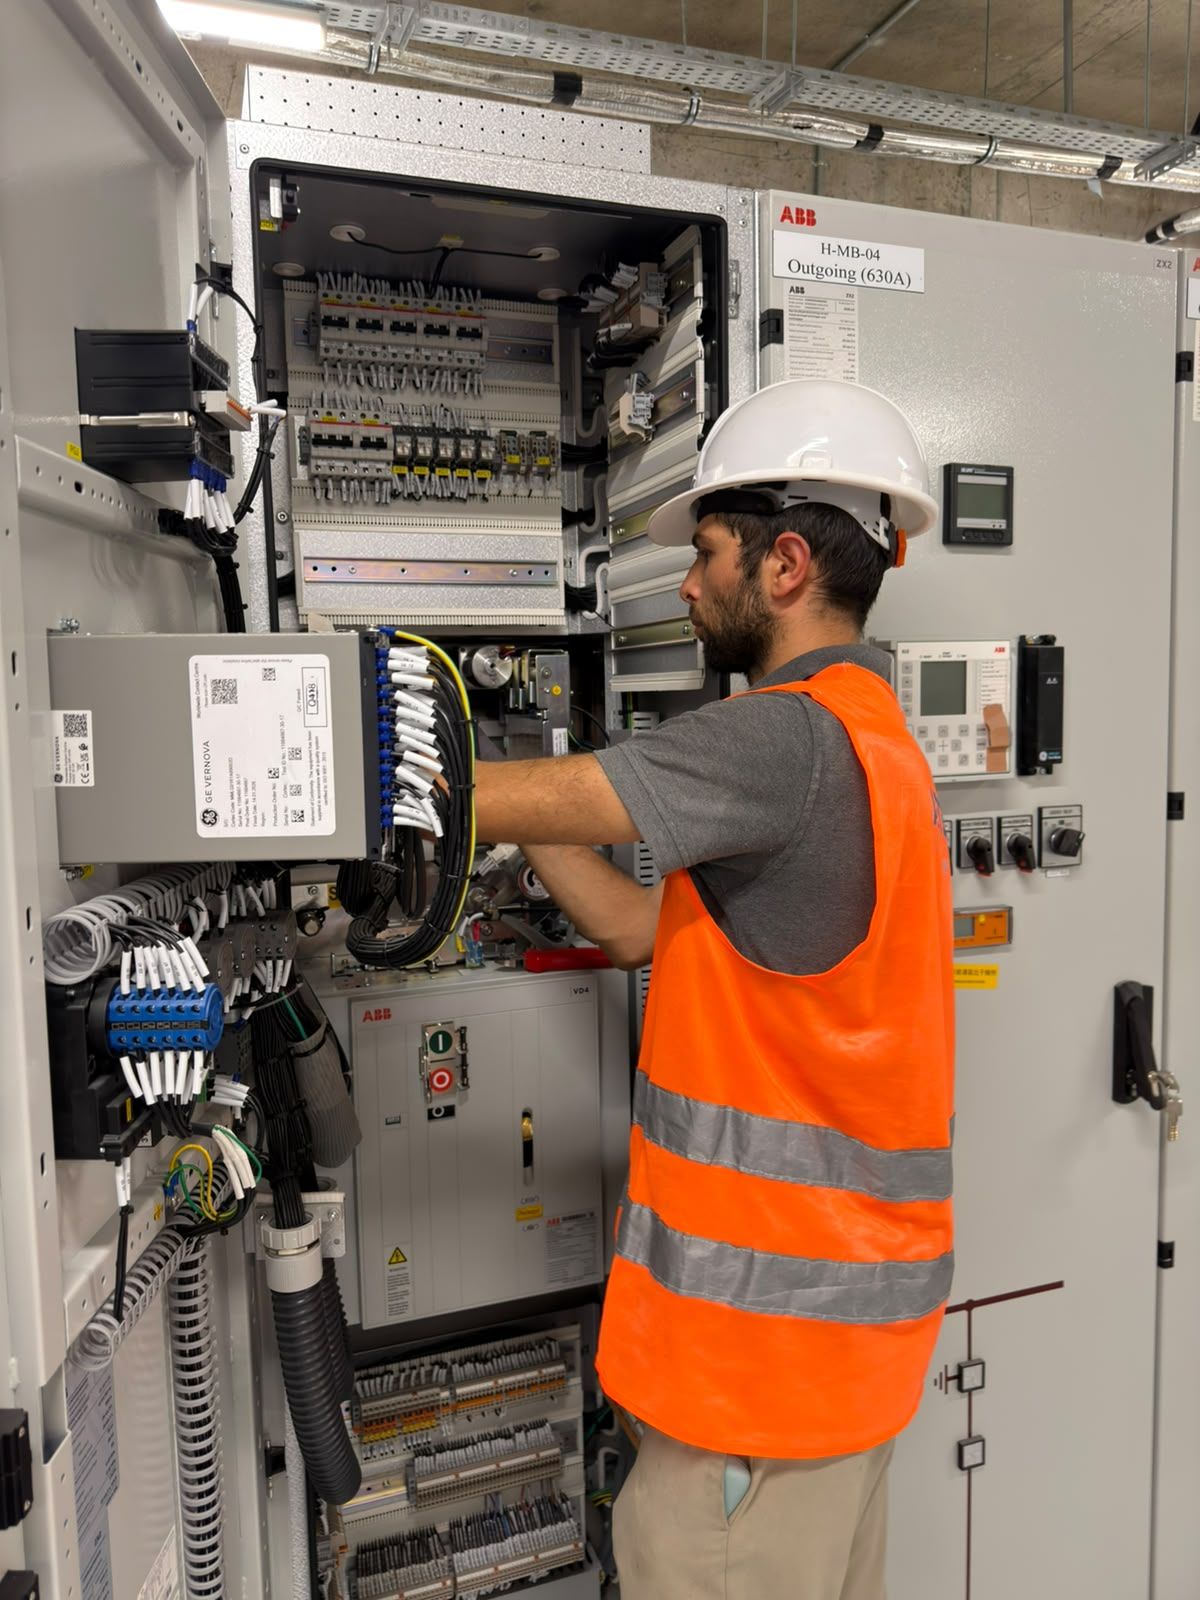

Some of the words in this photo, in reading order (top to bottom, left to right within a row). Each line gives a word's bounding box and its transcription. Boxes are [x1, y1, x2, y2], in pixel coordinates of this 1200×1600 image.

[780, 206, 817, 227] ABB
[820, 242, 880, 261] H-MB-04
[1156, 259, 1172, 269] ZX2
[788, 258, 857, 282] Outgoing
[860, 268, 912, 288] (630A)
[789, 286, 805, 294] ABB
[203, 740, 212, 788] VERNOVA
[205, 790, 212, 803] GE
[362, 1008, 392, 1022] ABB
